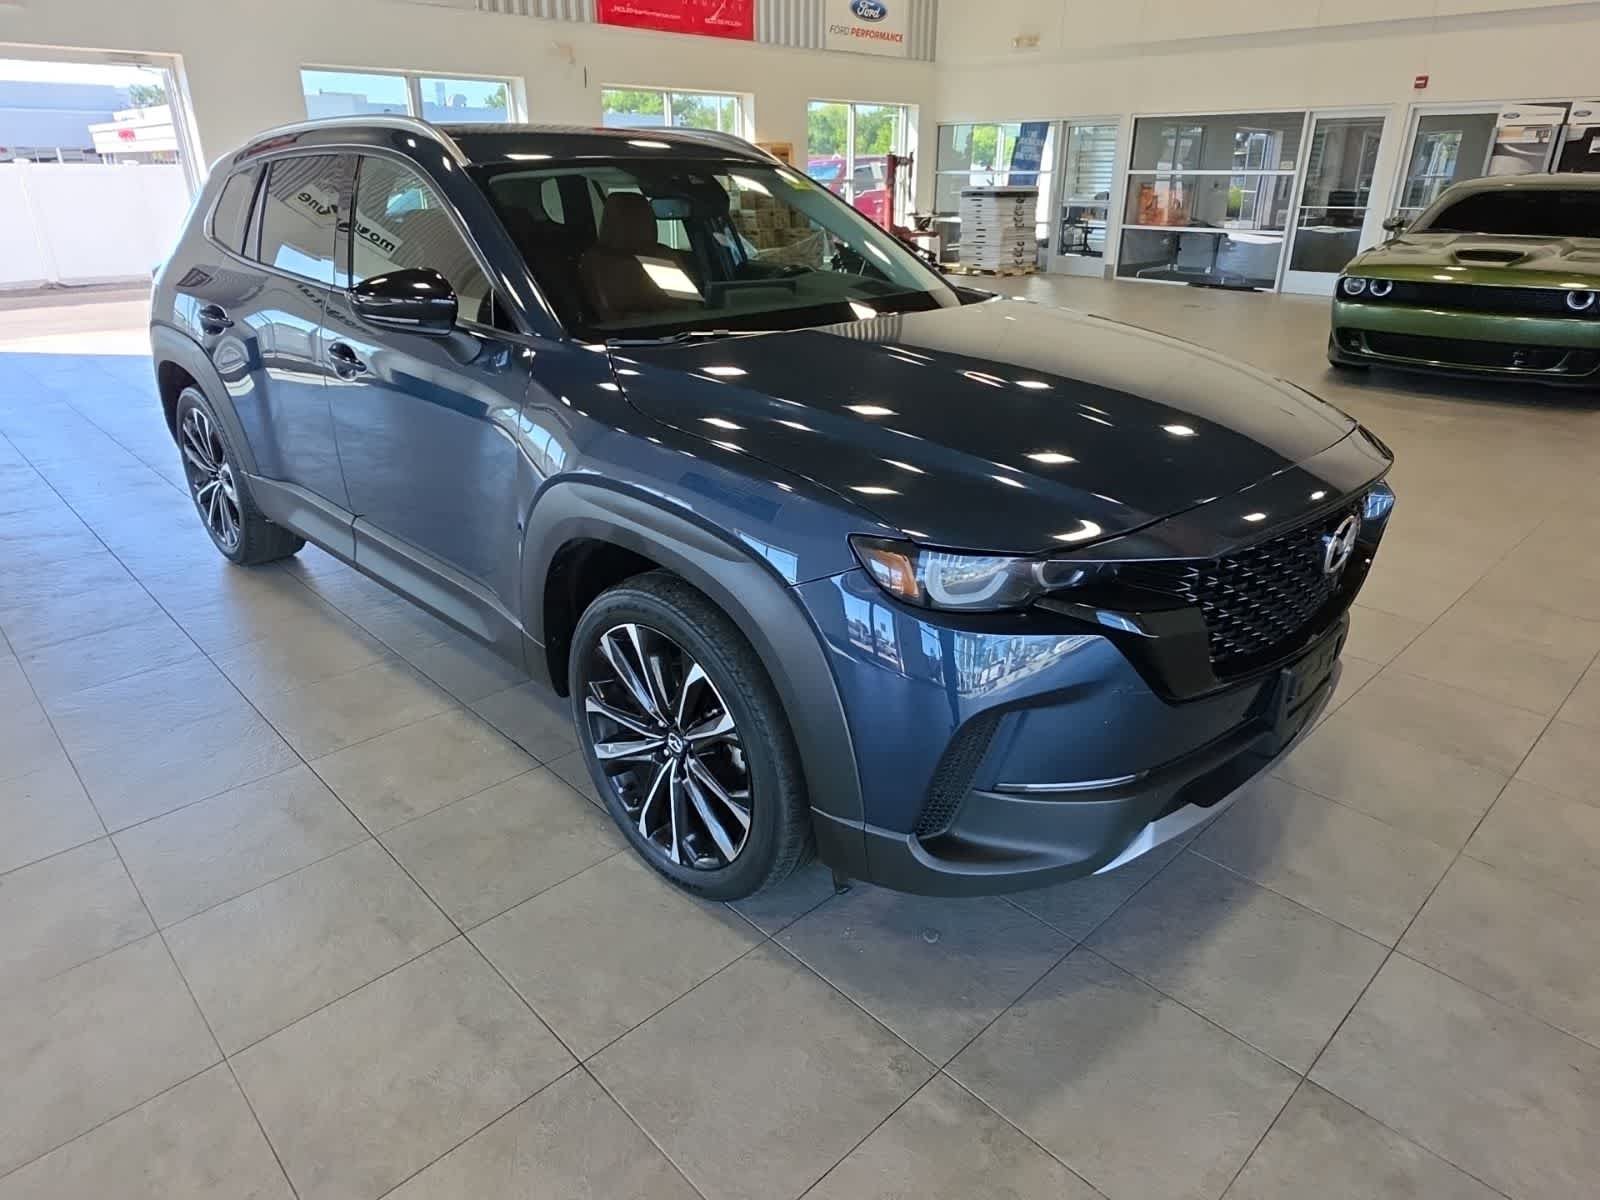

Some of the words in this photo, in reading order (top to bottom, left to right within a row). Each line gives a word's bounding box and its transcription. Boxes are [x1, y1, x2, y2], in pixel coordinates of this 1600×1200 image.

[857, 0, 880, 17] Ford
[829, 25, 849, 35] FORD
[851, 27, 904, 42] PERFORMANCE
